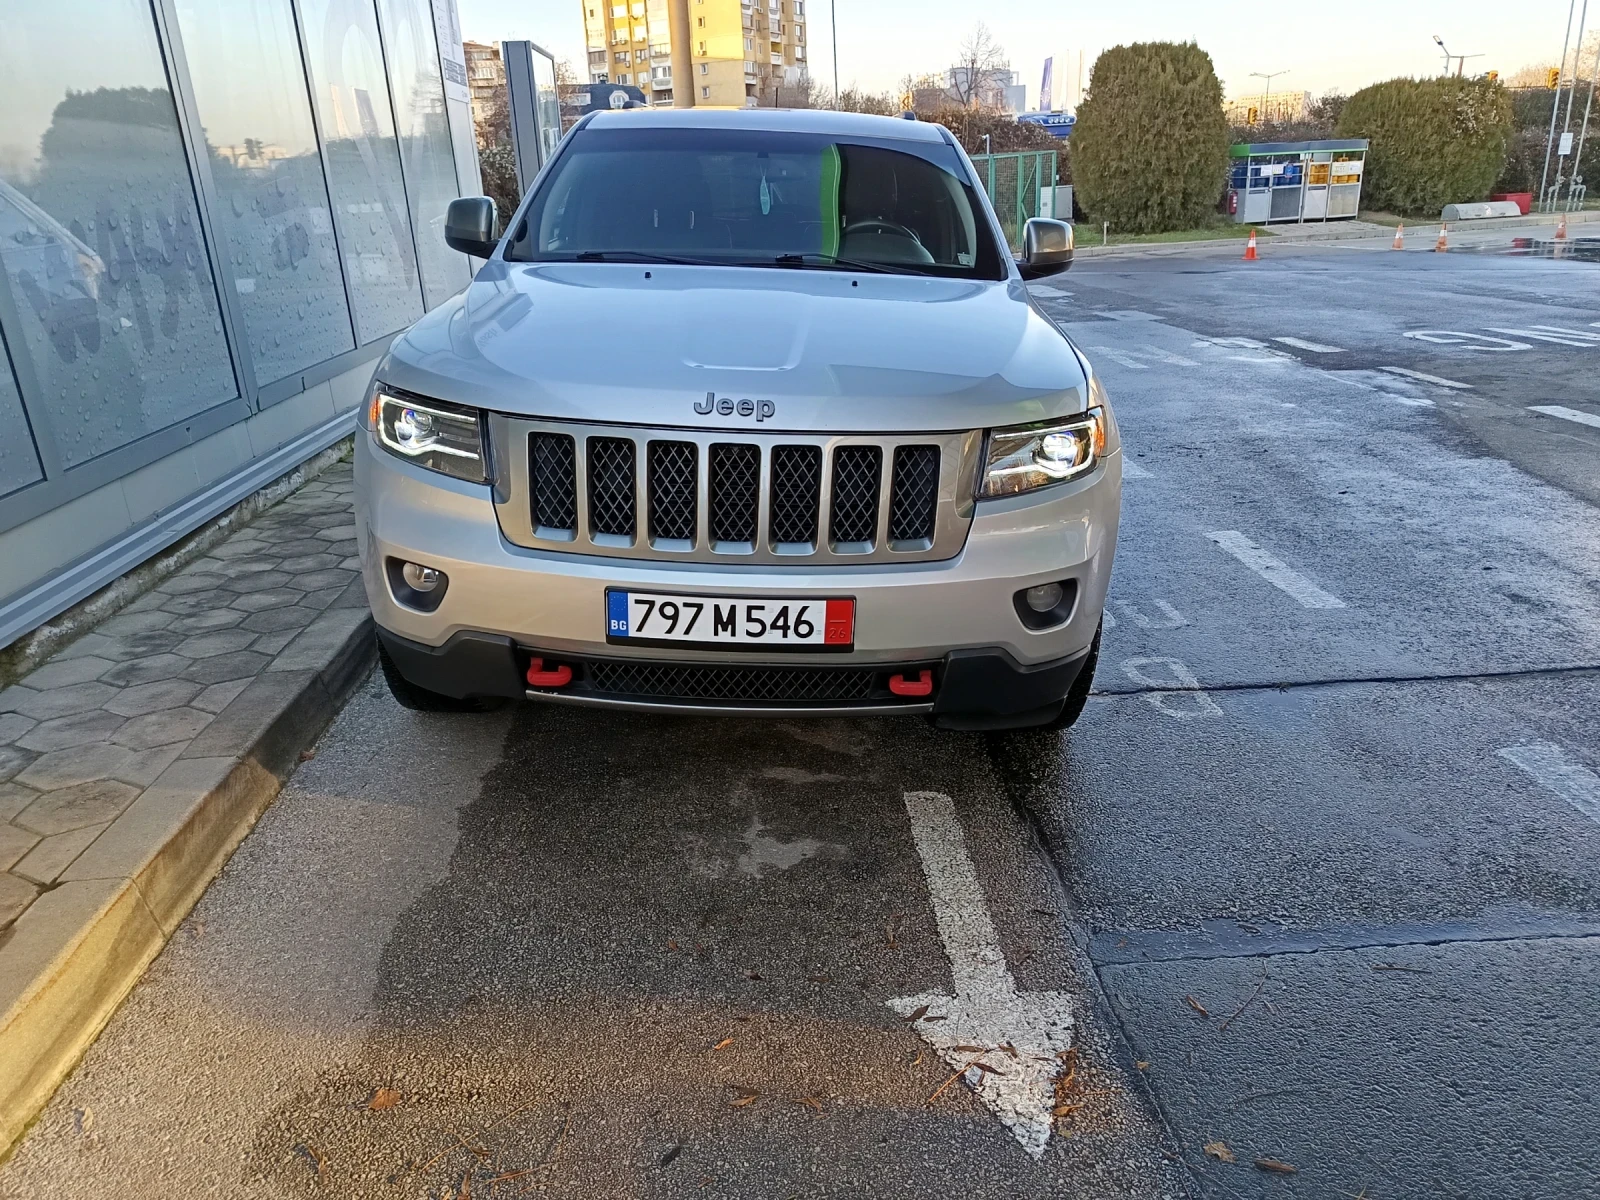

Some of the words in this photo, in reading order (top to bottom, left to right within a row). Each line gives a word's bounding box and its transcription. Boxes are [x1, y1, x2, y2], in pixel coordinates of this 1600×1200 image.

[693, 392, 775, 422] Jeep
[610, 619, 627, 631] BG
[634, 598, 704, 636] 797
[829, 627, 846, 639] 26
